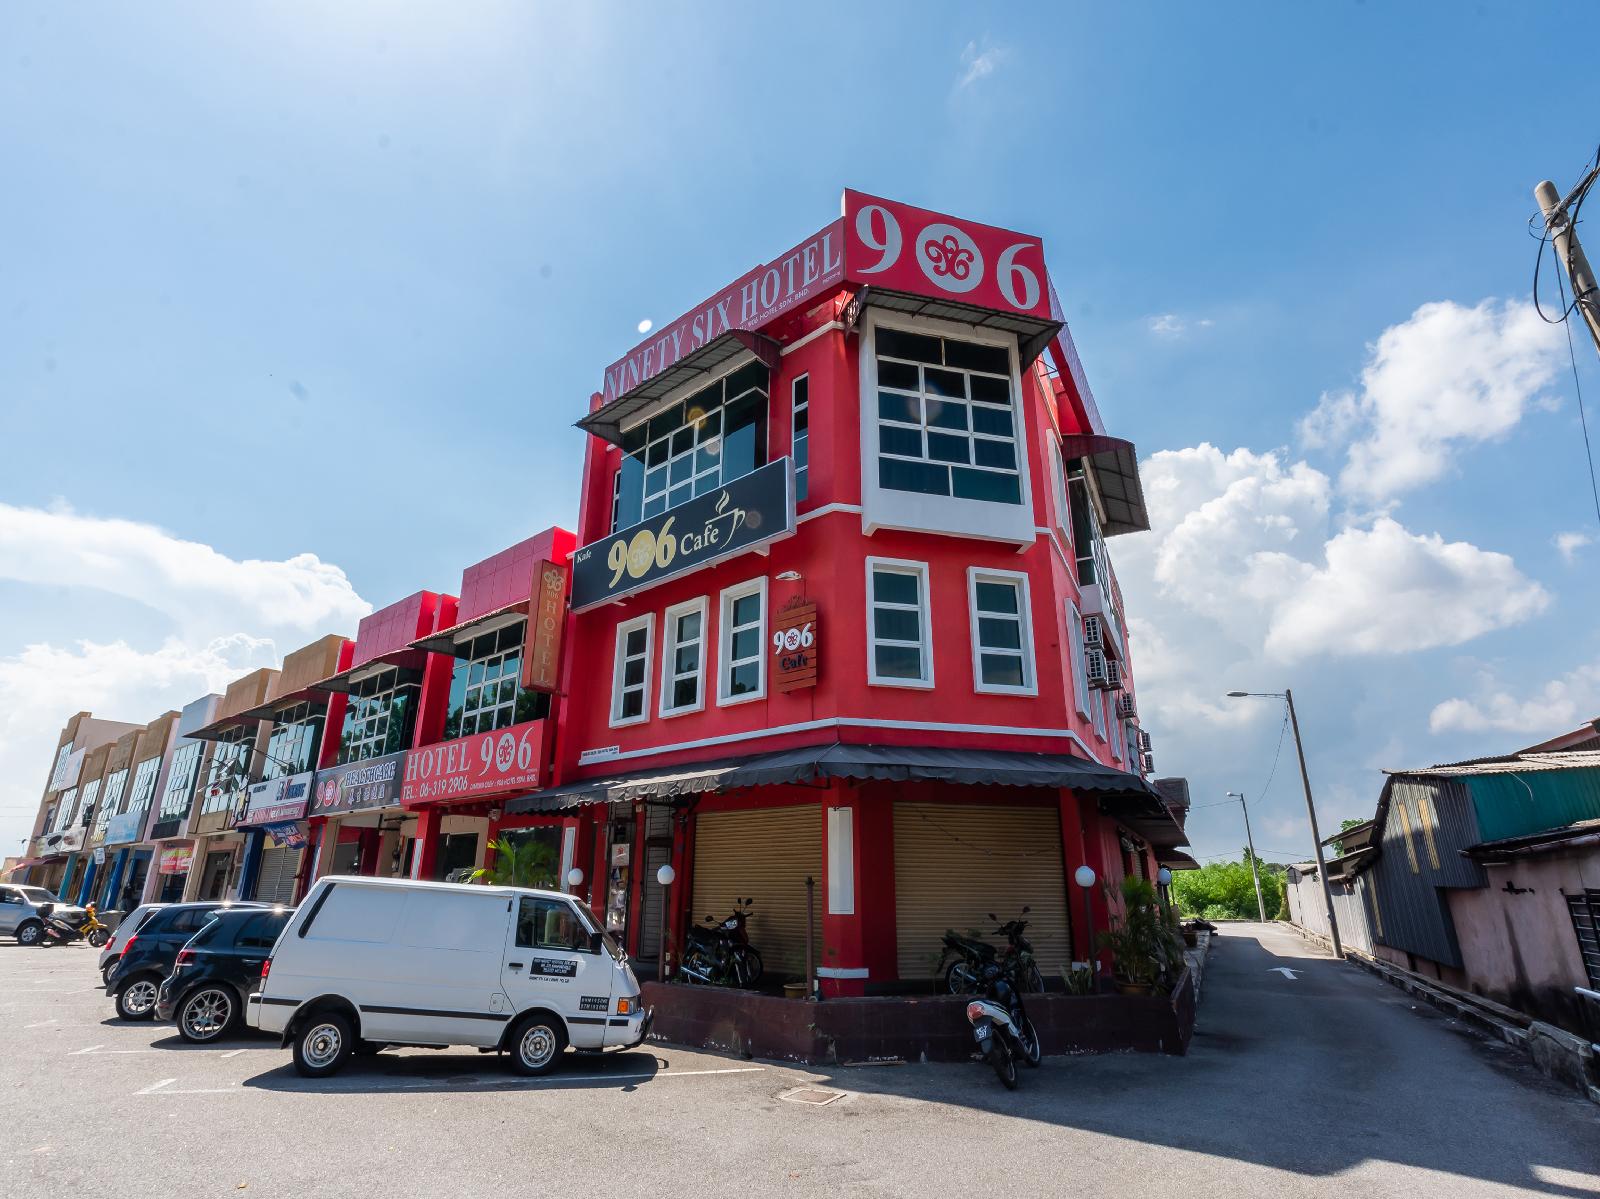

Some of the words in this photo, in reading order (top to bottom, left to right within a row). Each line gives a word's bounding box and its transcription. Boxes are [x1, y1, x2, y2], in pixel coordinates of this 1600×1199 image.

[604, 325, 685, 402] NINETY
[691, 297, 734, 351] SIX
[740, 231, 842, 322] HOTEL
[759, 306, 778, 321] HOTEL
[680, 524, 719, 556] Cafe
[539, 600, 557, 684] HOTEL
[406, 742, 472, 782] HOTEL
[419, 779, 447, 798] 06-319
[448, 775, 468, 794] 2906
